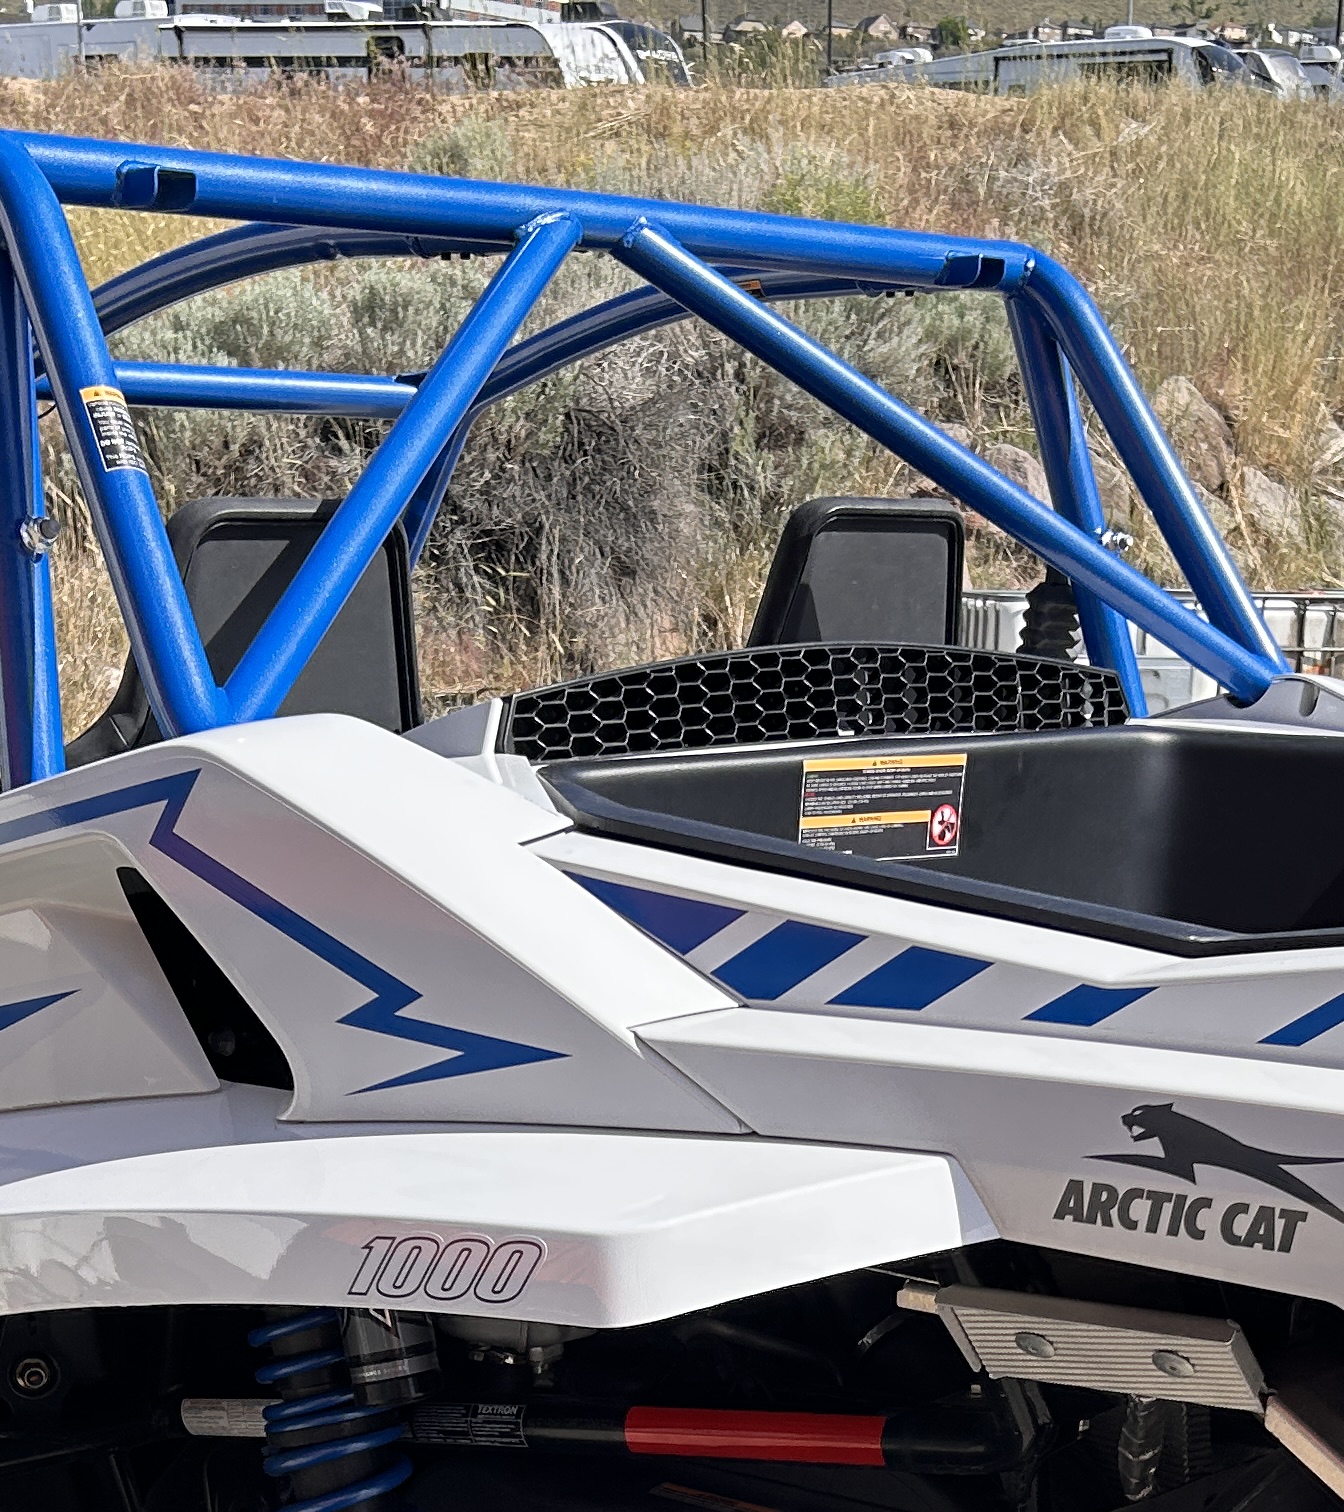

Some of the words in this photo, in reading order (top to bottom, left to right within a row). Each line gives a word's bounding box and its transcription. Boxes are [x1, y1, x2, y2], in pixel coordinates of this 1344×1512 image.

[1052, 1178, 1213, 1241] ARCTIC
[1220, 1202, 1309, 1253] CAT
[347, 1236, 542, 1304] 1000
[477, 1404, 518, 1414] TEXTRON
